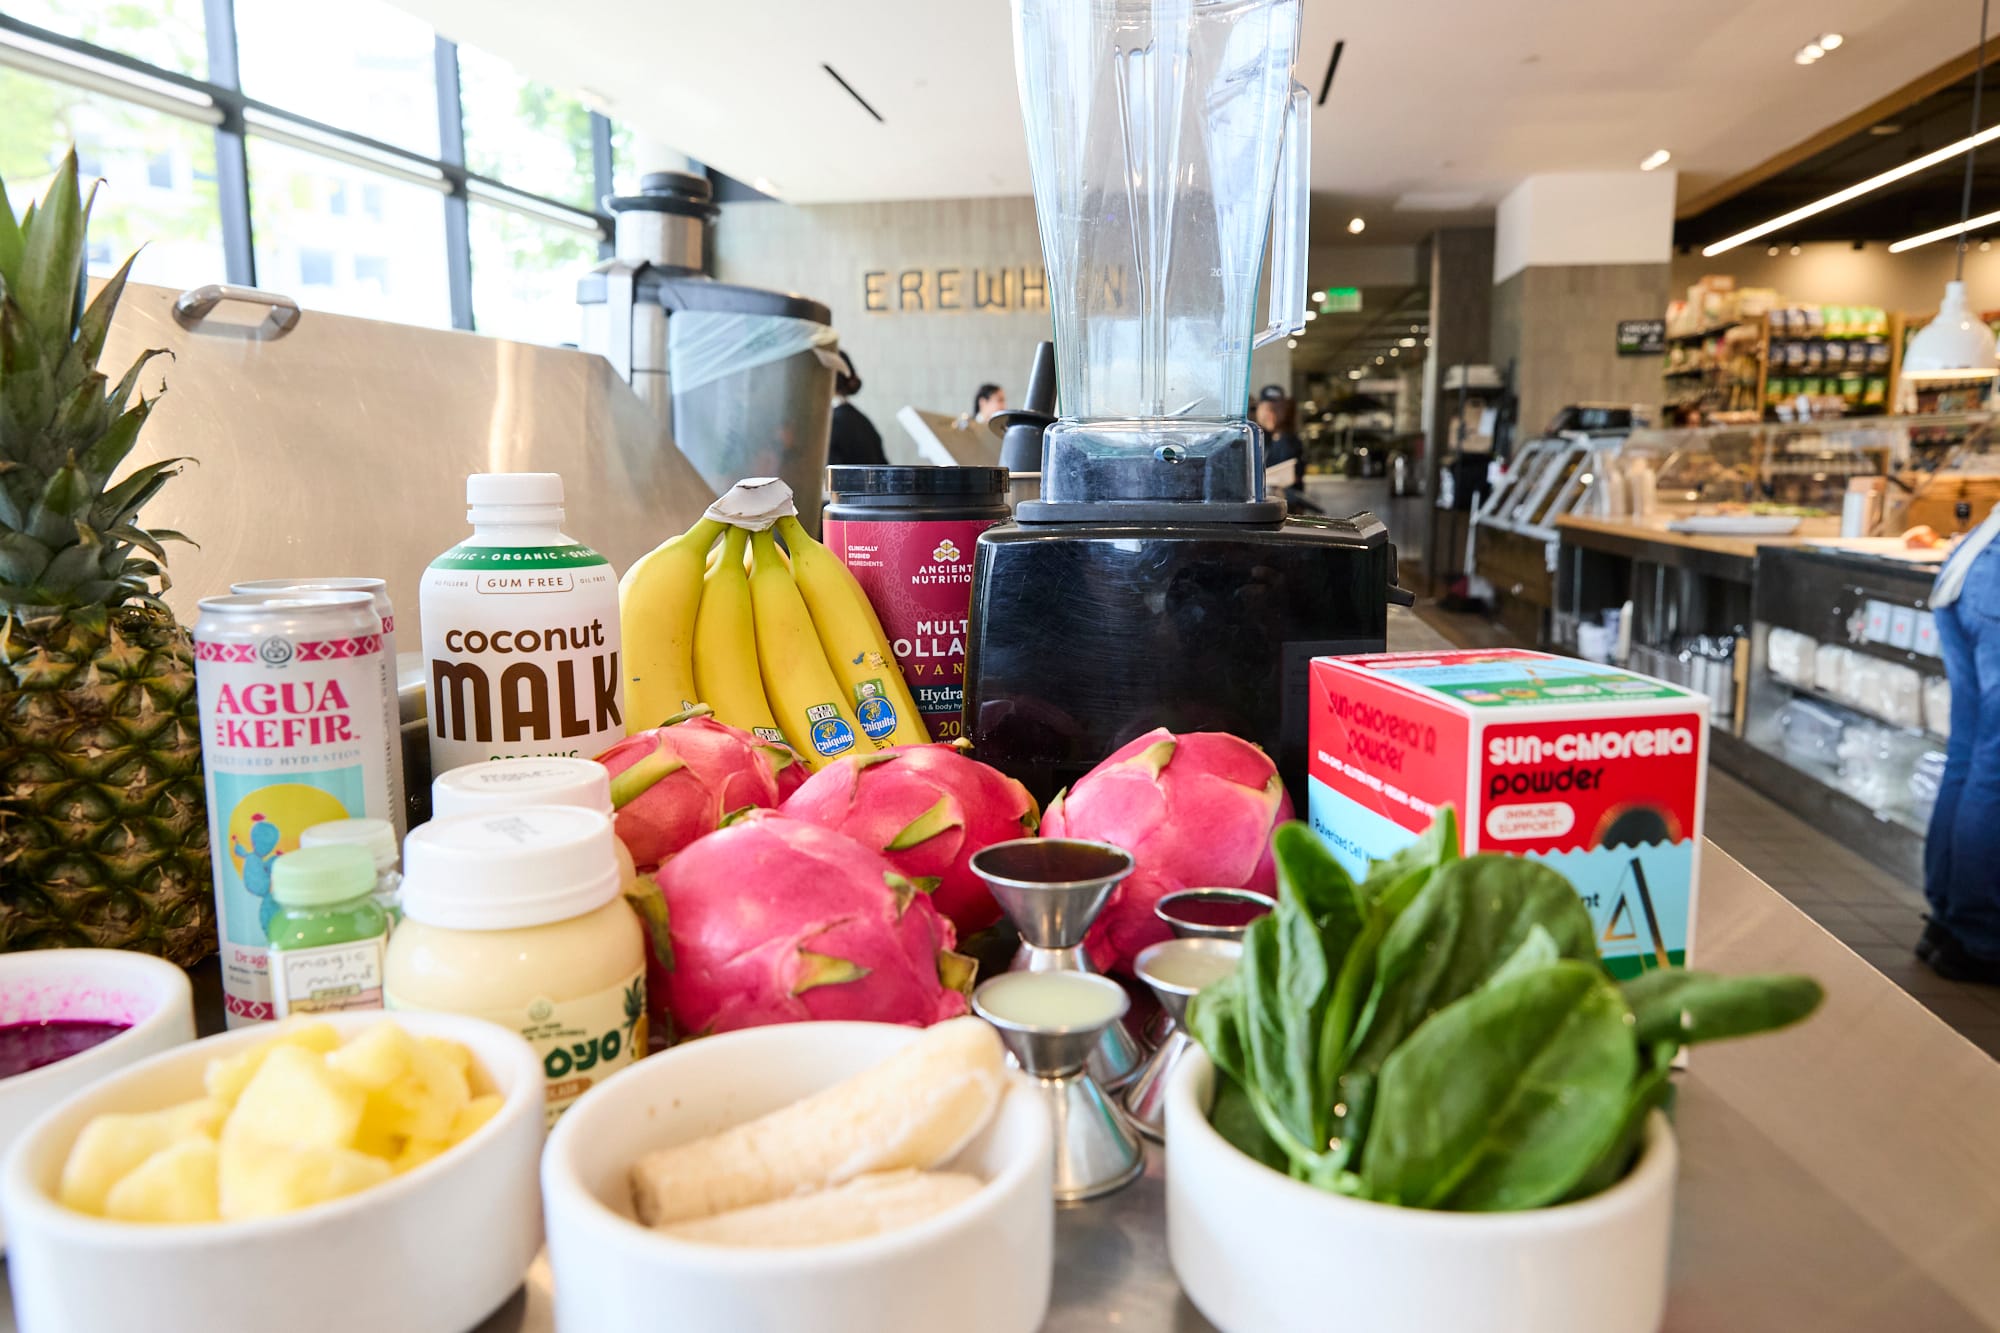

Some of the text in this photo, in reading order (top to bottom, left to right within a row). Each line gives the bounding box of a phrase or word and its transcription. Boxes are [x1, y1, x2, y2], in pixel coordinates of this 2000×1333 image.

[863, 268, 1126, 312] EREWHN
[491, 552, 558, 561] ORGANIC
[919, 564, 973, 575] ANCIENT
[487, 577, 564, 588] GUM FREE
[912, 575, 971, 585] NUTRITIO
[446, 618, 605, 654] coconut
[917, 620, 968, 636] MULT
[892, 637, 965, 658] OLLA
[215, 679, 350, 716] AGUA
[919, 687, 964, 704] Hydra
[934, 703, 953, 711] body
[227, 714, 352, 748] KEFIR
[861, 717, 896, 732] Chiquita
[938, 720, 961, 737] 20
[816, 733, 854, 752] Chiquita
[1347, 729, 1405, 773] powder
[212, 748, 361, 767] CULTURED HYDRATION
[1489, 765, 1605, 800] powder
[290, 951, 367, 970] magic
[306, 965, 374, 988] mind
